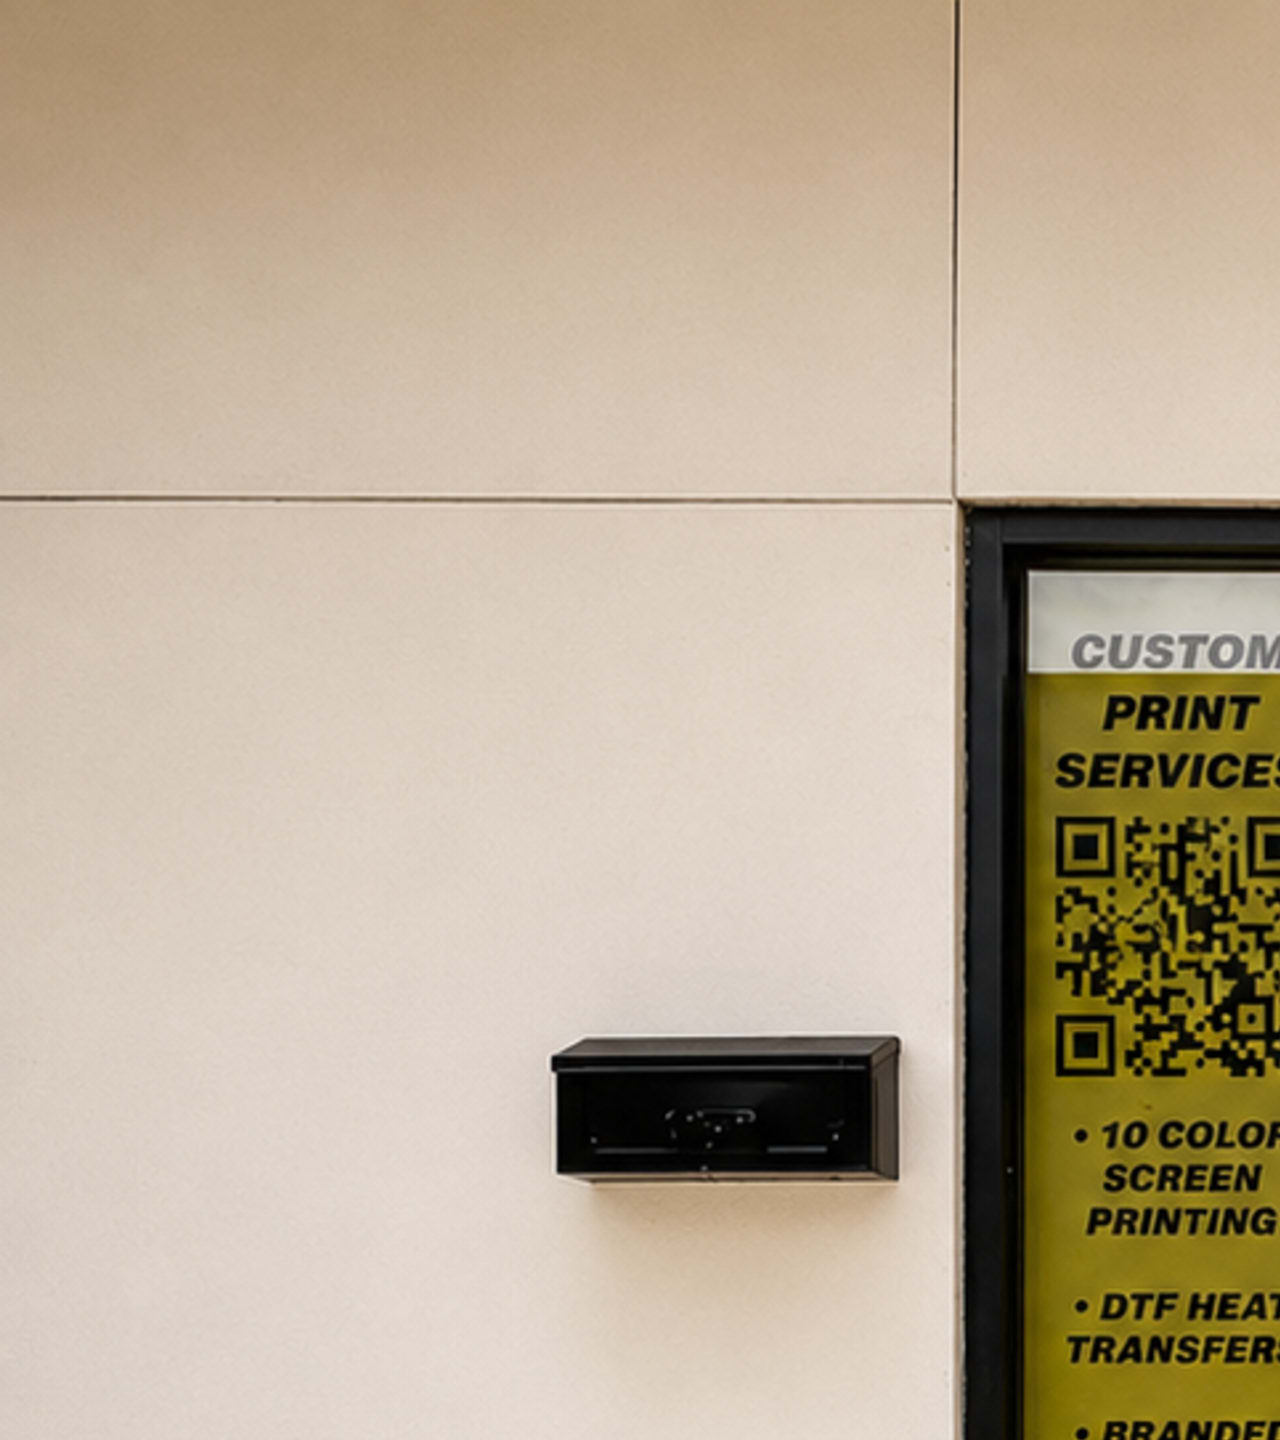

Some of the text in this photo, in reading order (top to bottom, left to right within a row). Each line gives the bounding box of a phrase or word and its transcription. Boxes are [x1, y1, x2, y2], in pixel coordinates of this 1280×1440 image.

[1102, 694, 1261, 731] PRINT
[1102, 1120, 1149, 1149] 10
[1103, 1163, 1263, 1193] SCREEN
[1086, 1206, 1277, 1236] PRINTING
[1100, 1292, 1180, 1321] DTF
